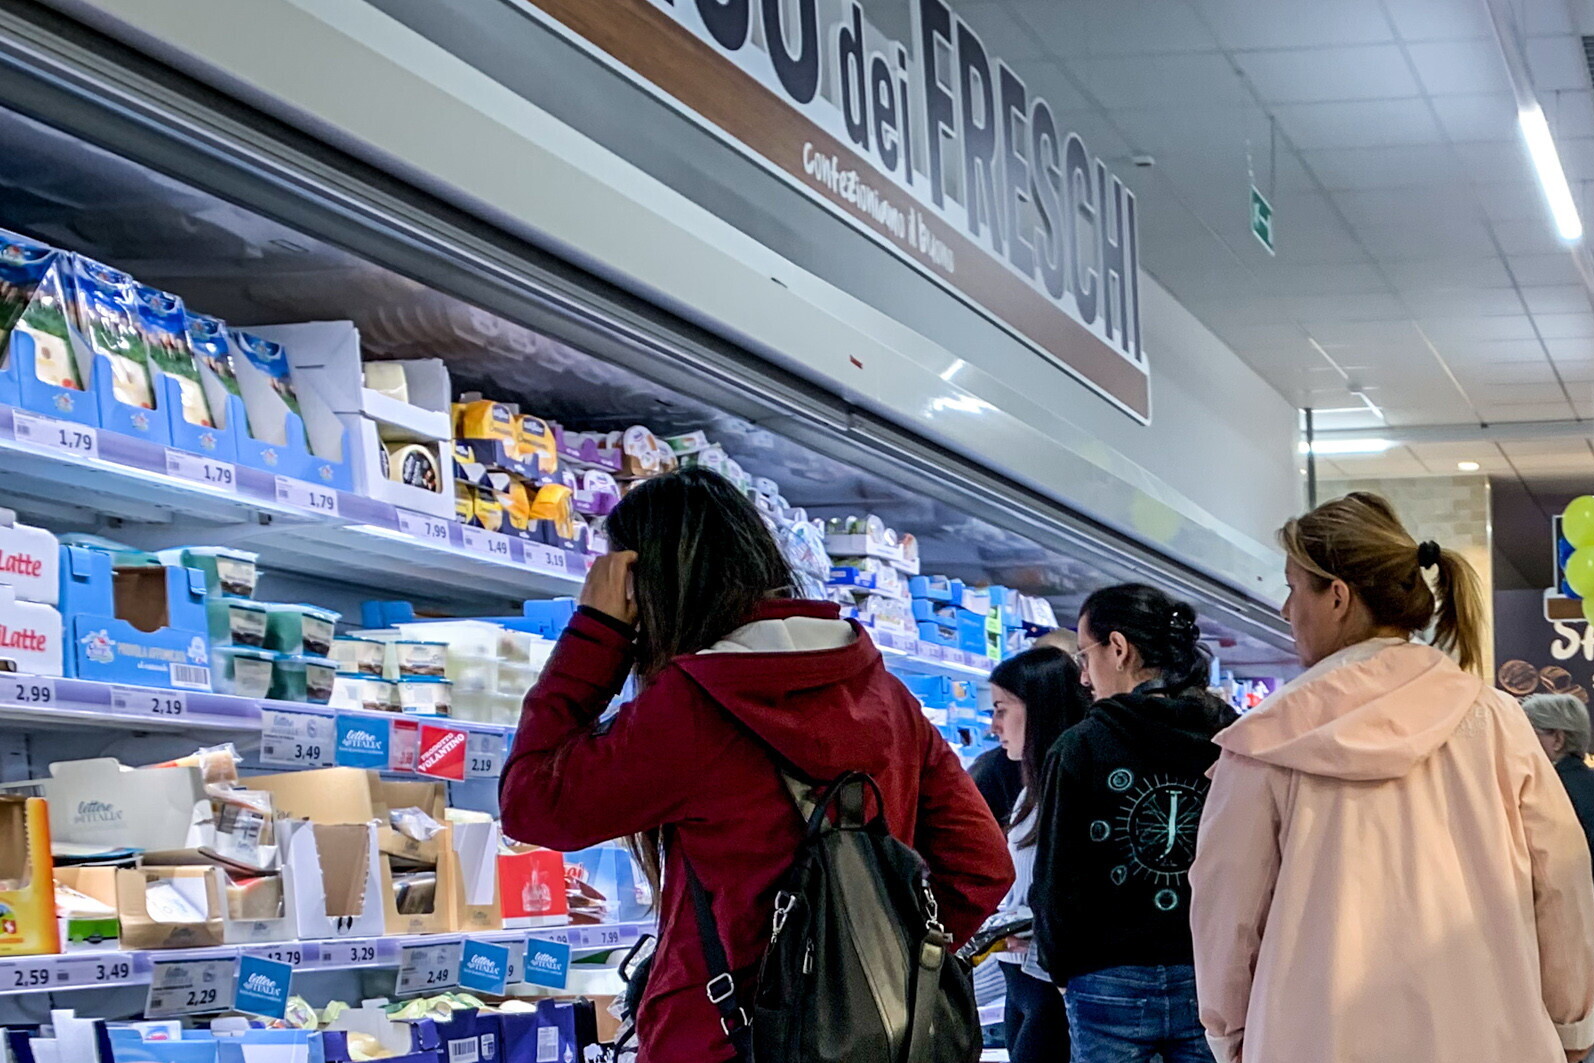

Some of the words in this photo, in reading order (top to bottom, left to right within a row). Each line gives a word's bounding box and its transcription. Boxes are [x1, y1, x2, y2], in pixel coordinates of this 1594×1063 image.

[838, 0, 915, 186] dei
[920, 0, 1144, 364] FRESCHI
[59, 428, 92, 451] 1,79
[203, 464, 233, 485] 1,79
[309, 491, 335, 511] 1,79
[424, 521, 448, 539] 7,99
[487, 538, 508, 555] 1,49
[545, 551, 565, 568] 3,19
[15, 684, 51, 703] 2,99
[152, 697, 182, 715] 2,19
[294, 744, 321, 760] 3,49
[417, 732, 466, 772] VOLANTINO
[420, 731, 455, 762] PRODOTTO
[471, 758, 492, 773] 2,19
[601, 932, 619, 944] 7,99
[350, 946, 375, 961] 3,29
[14, 968, 50, 987] 2,59
[96, 962, 130, 981] 3,49
[427, 969, 449, 984] 2,49
[186, 988, 217, 1007] 2,29
